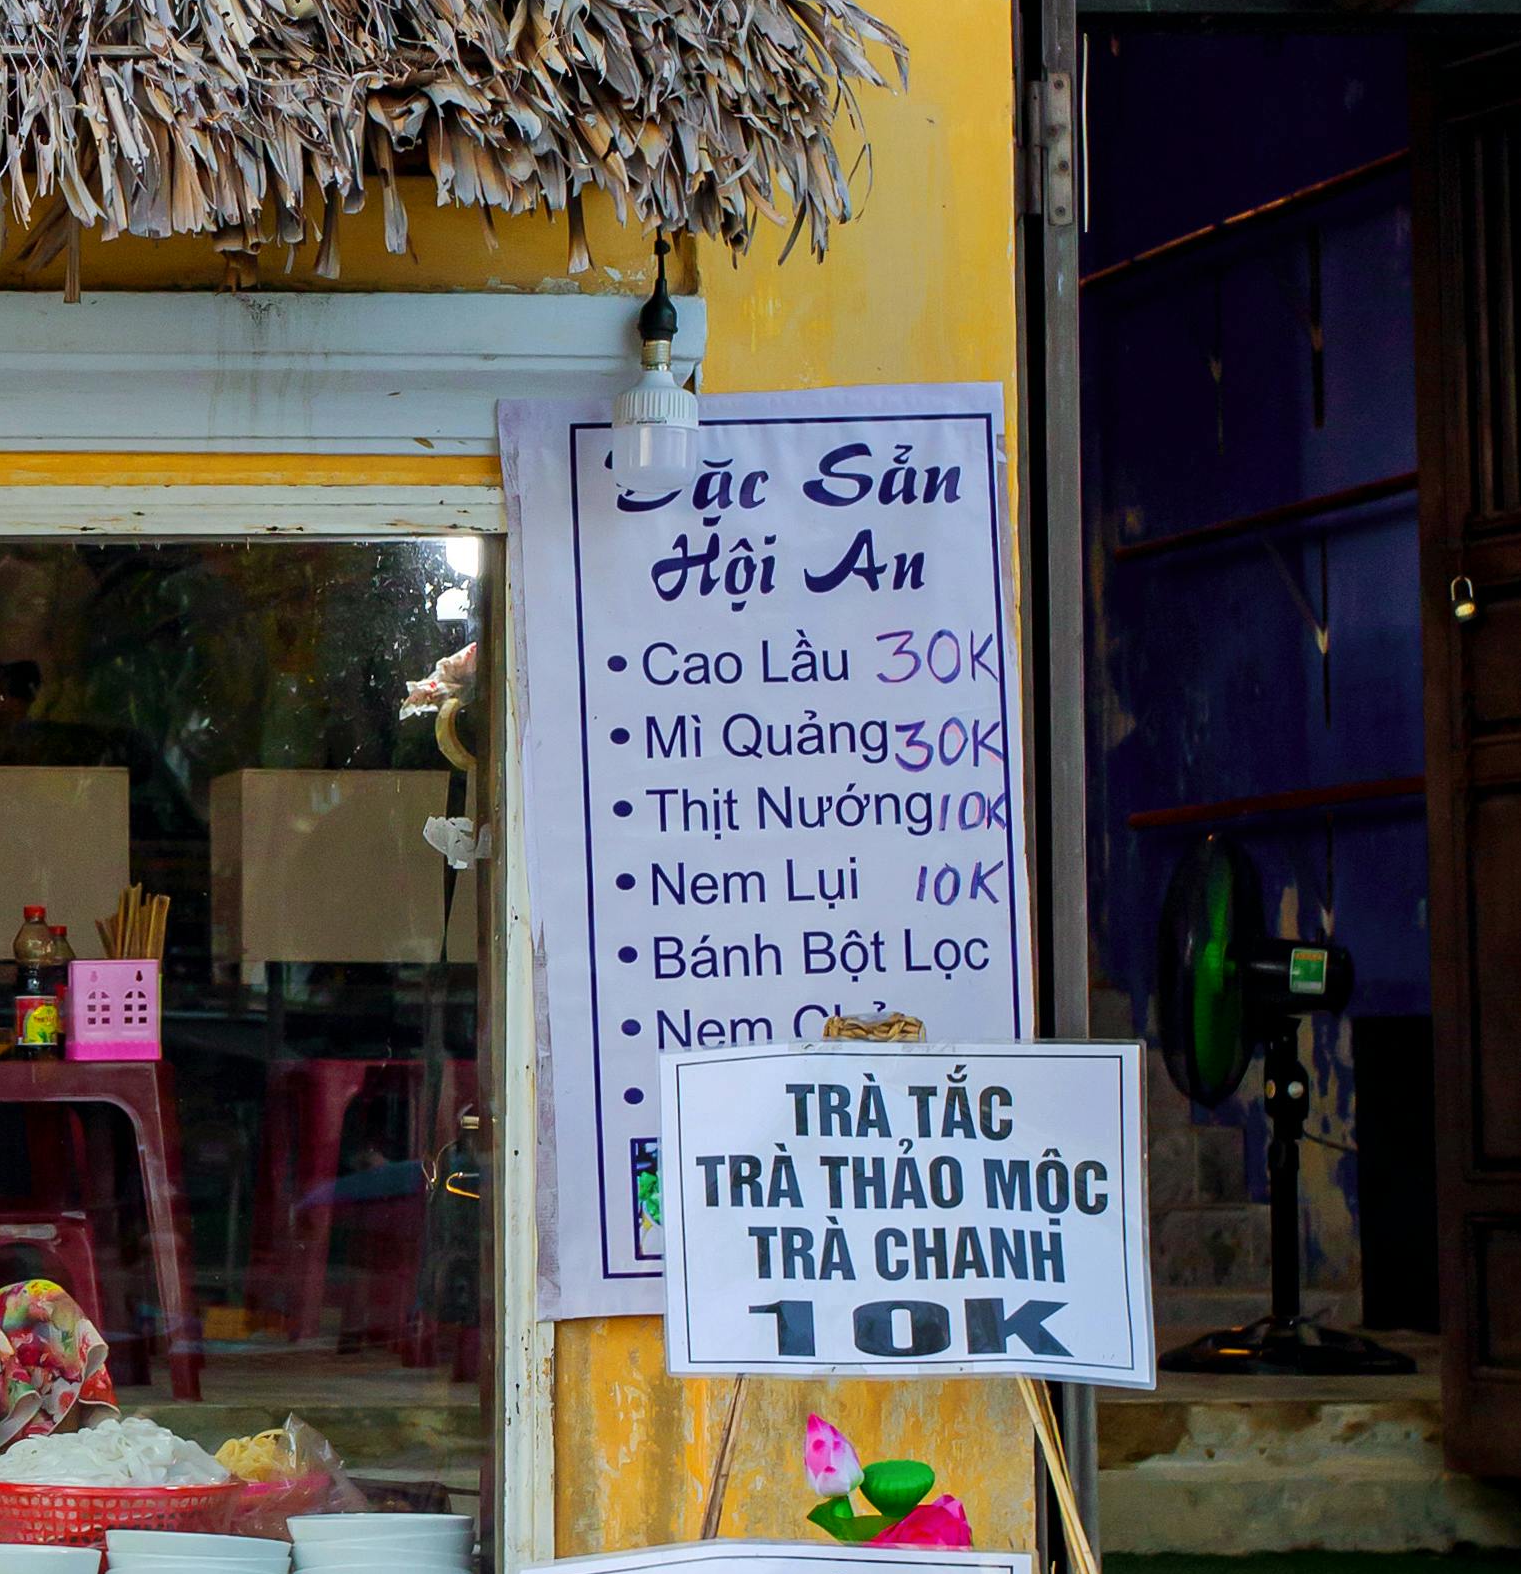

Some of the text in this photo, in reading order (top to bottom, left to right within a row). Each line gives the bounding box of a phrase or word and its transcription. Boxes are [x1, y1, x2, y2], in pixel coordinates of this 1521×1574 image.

[802, 442, 961, 506] Sản
[650, 528, 927, 612] Hội An
[642, 628, 998, 685] Cao Lầu 30K
[645, 711, 1004, 772] Mì Quảng 30K
[646, 783, 1007, 840] Thịt Nướng 10K
[652, 857, 1004, 909] Nem Lụi 10K
[654, 928, 990, 981] Bánh Bột Lọc
[657, 1008, 773, 1050] Nem
[785, 1063, 1013, 1140] TRÀ TẮC
[696, 1138, 1109, 1225] TRÀ THẢO MỘC
[748, 1215, 1066, 1283] TRÀ CHANH
[748, 1297, 1075, 1358] 10K
